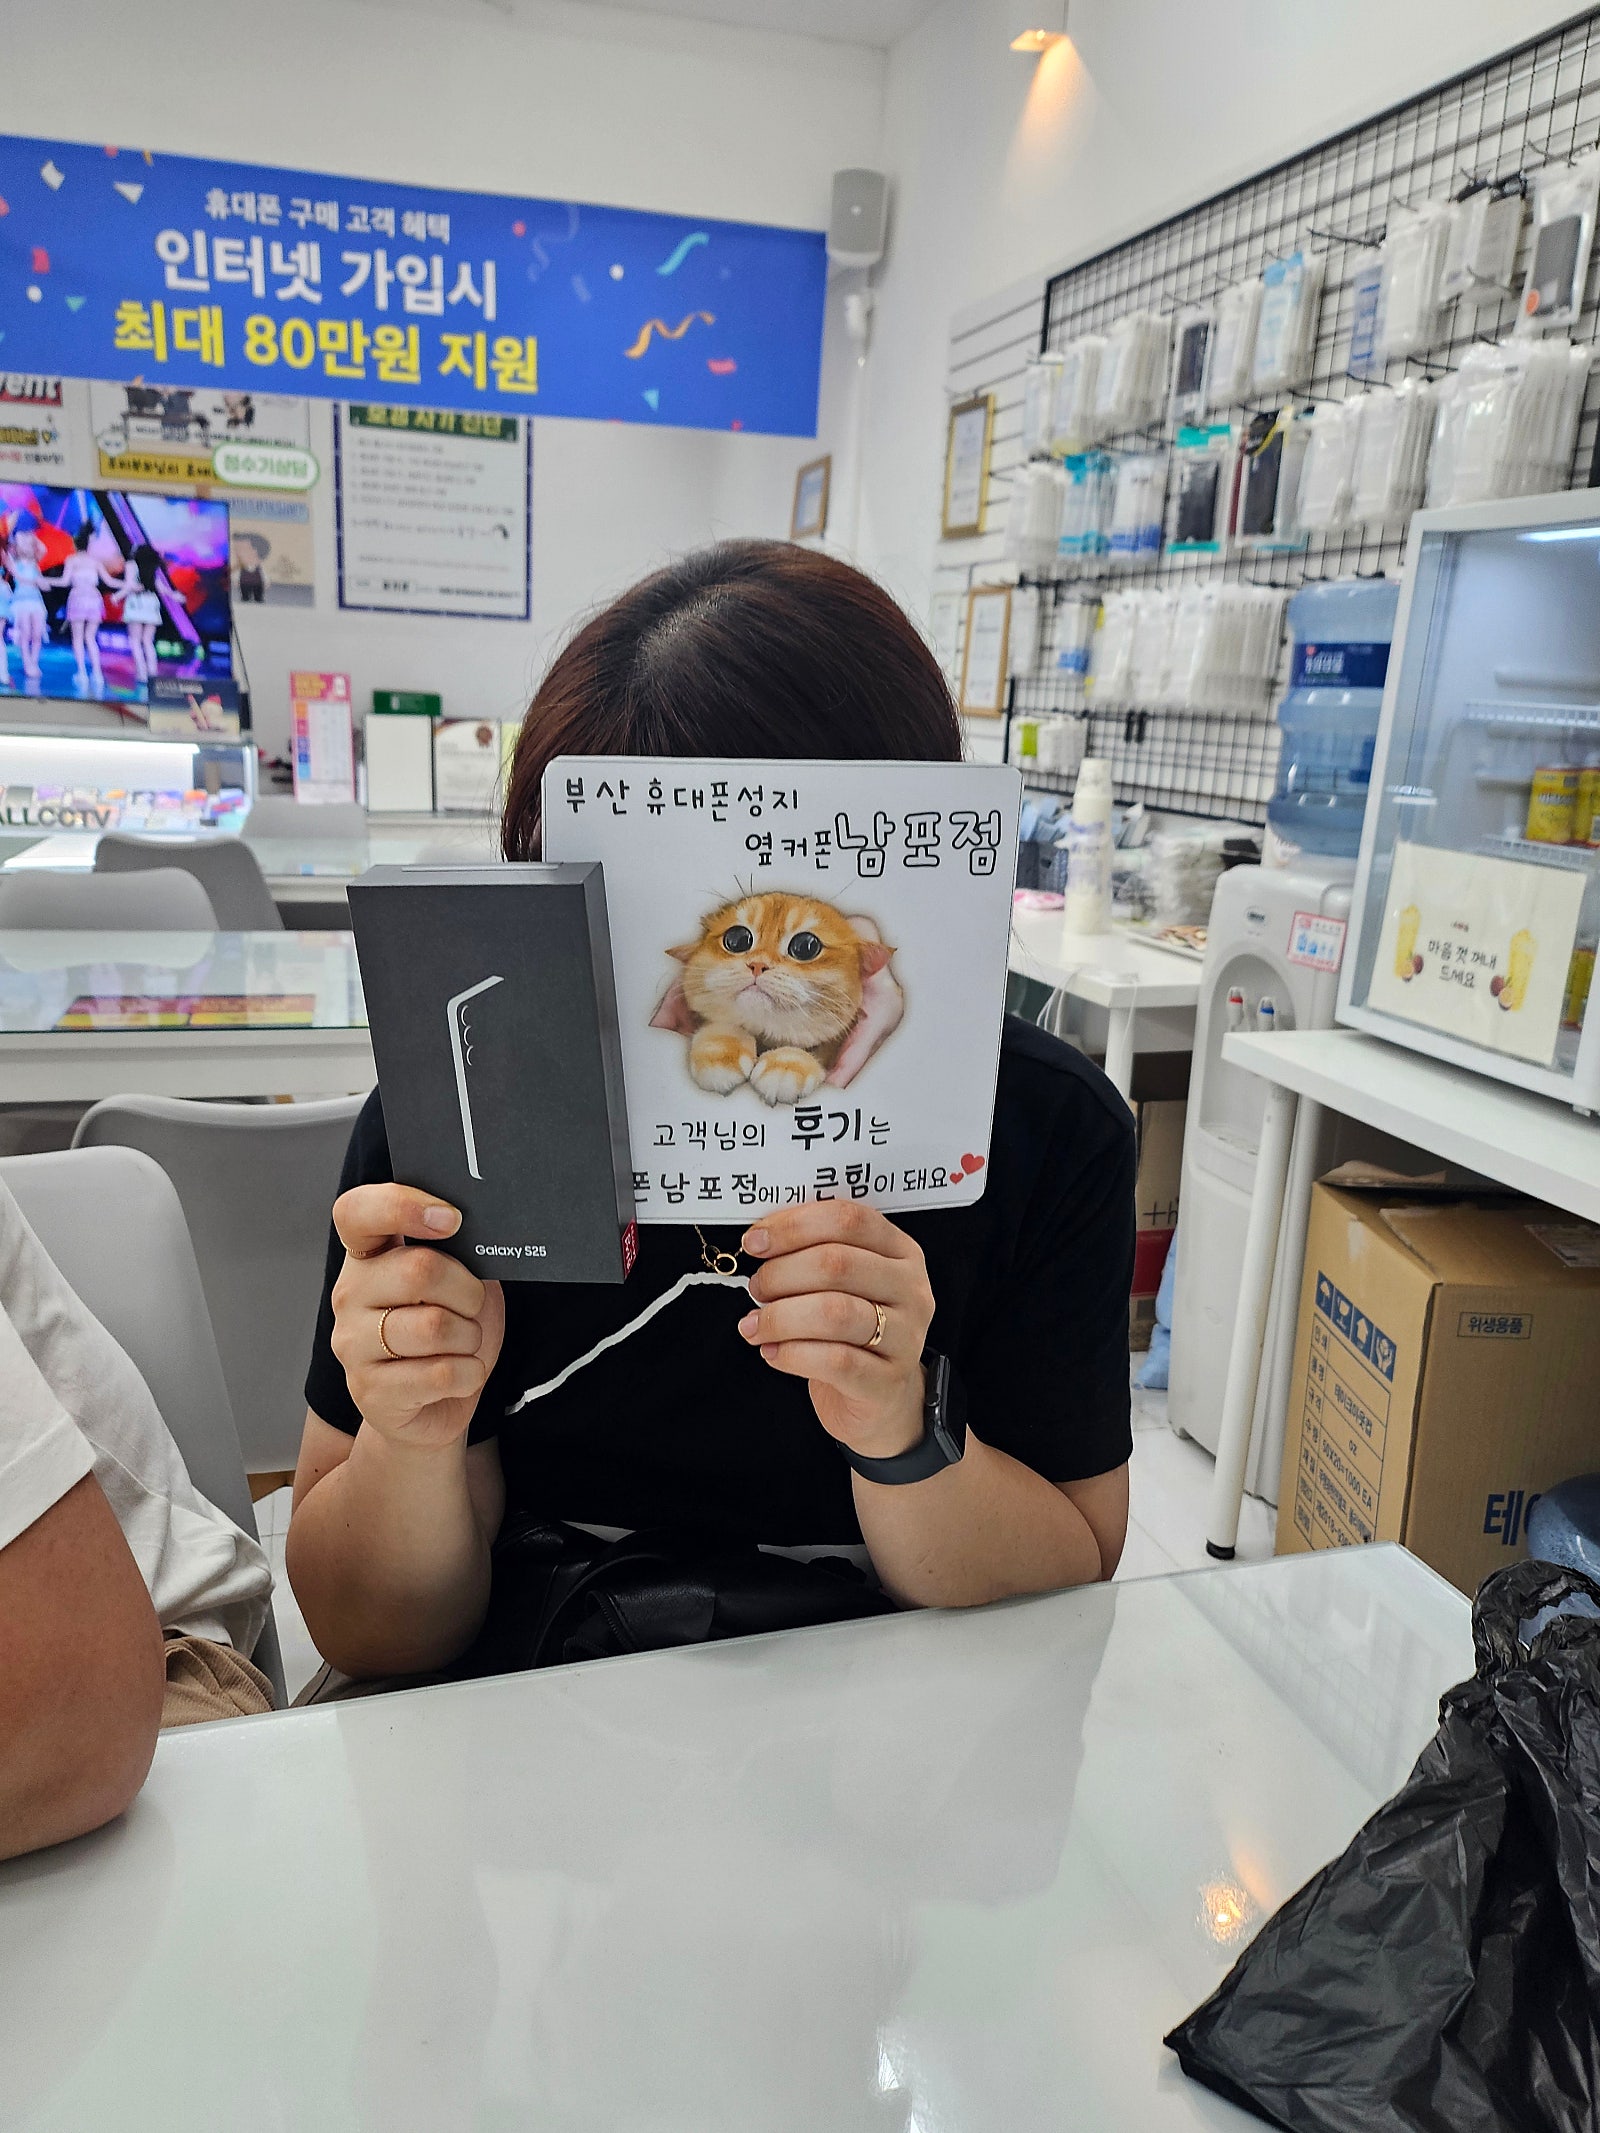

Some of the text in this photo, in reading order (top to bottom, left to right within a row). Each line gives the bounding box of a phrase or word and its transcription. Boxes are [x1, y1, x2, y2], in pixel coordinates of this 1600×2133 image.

[205, 187, 450, 245] 휴대폰 구매 고객 혜택
[155, 229, 498, 321] 인터넷 가입시
[114, 300, 538, 394] 최대 80만원 지원
[0, 806, 111, 828] LLCCTV
[566, 777, 799, 823] 부산 휴대폰성지
[653, 1105, 891, 1151] 고객님의 후기는
[902, 1165, 948, 1192] 돼요
[475, 1244, 547, 1258] Galaxy S25
[1468, 1315, 1524, 1335] 위생용품
[1361, 1487, 1372, 1512] EA
